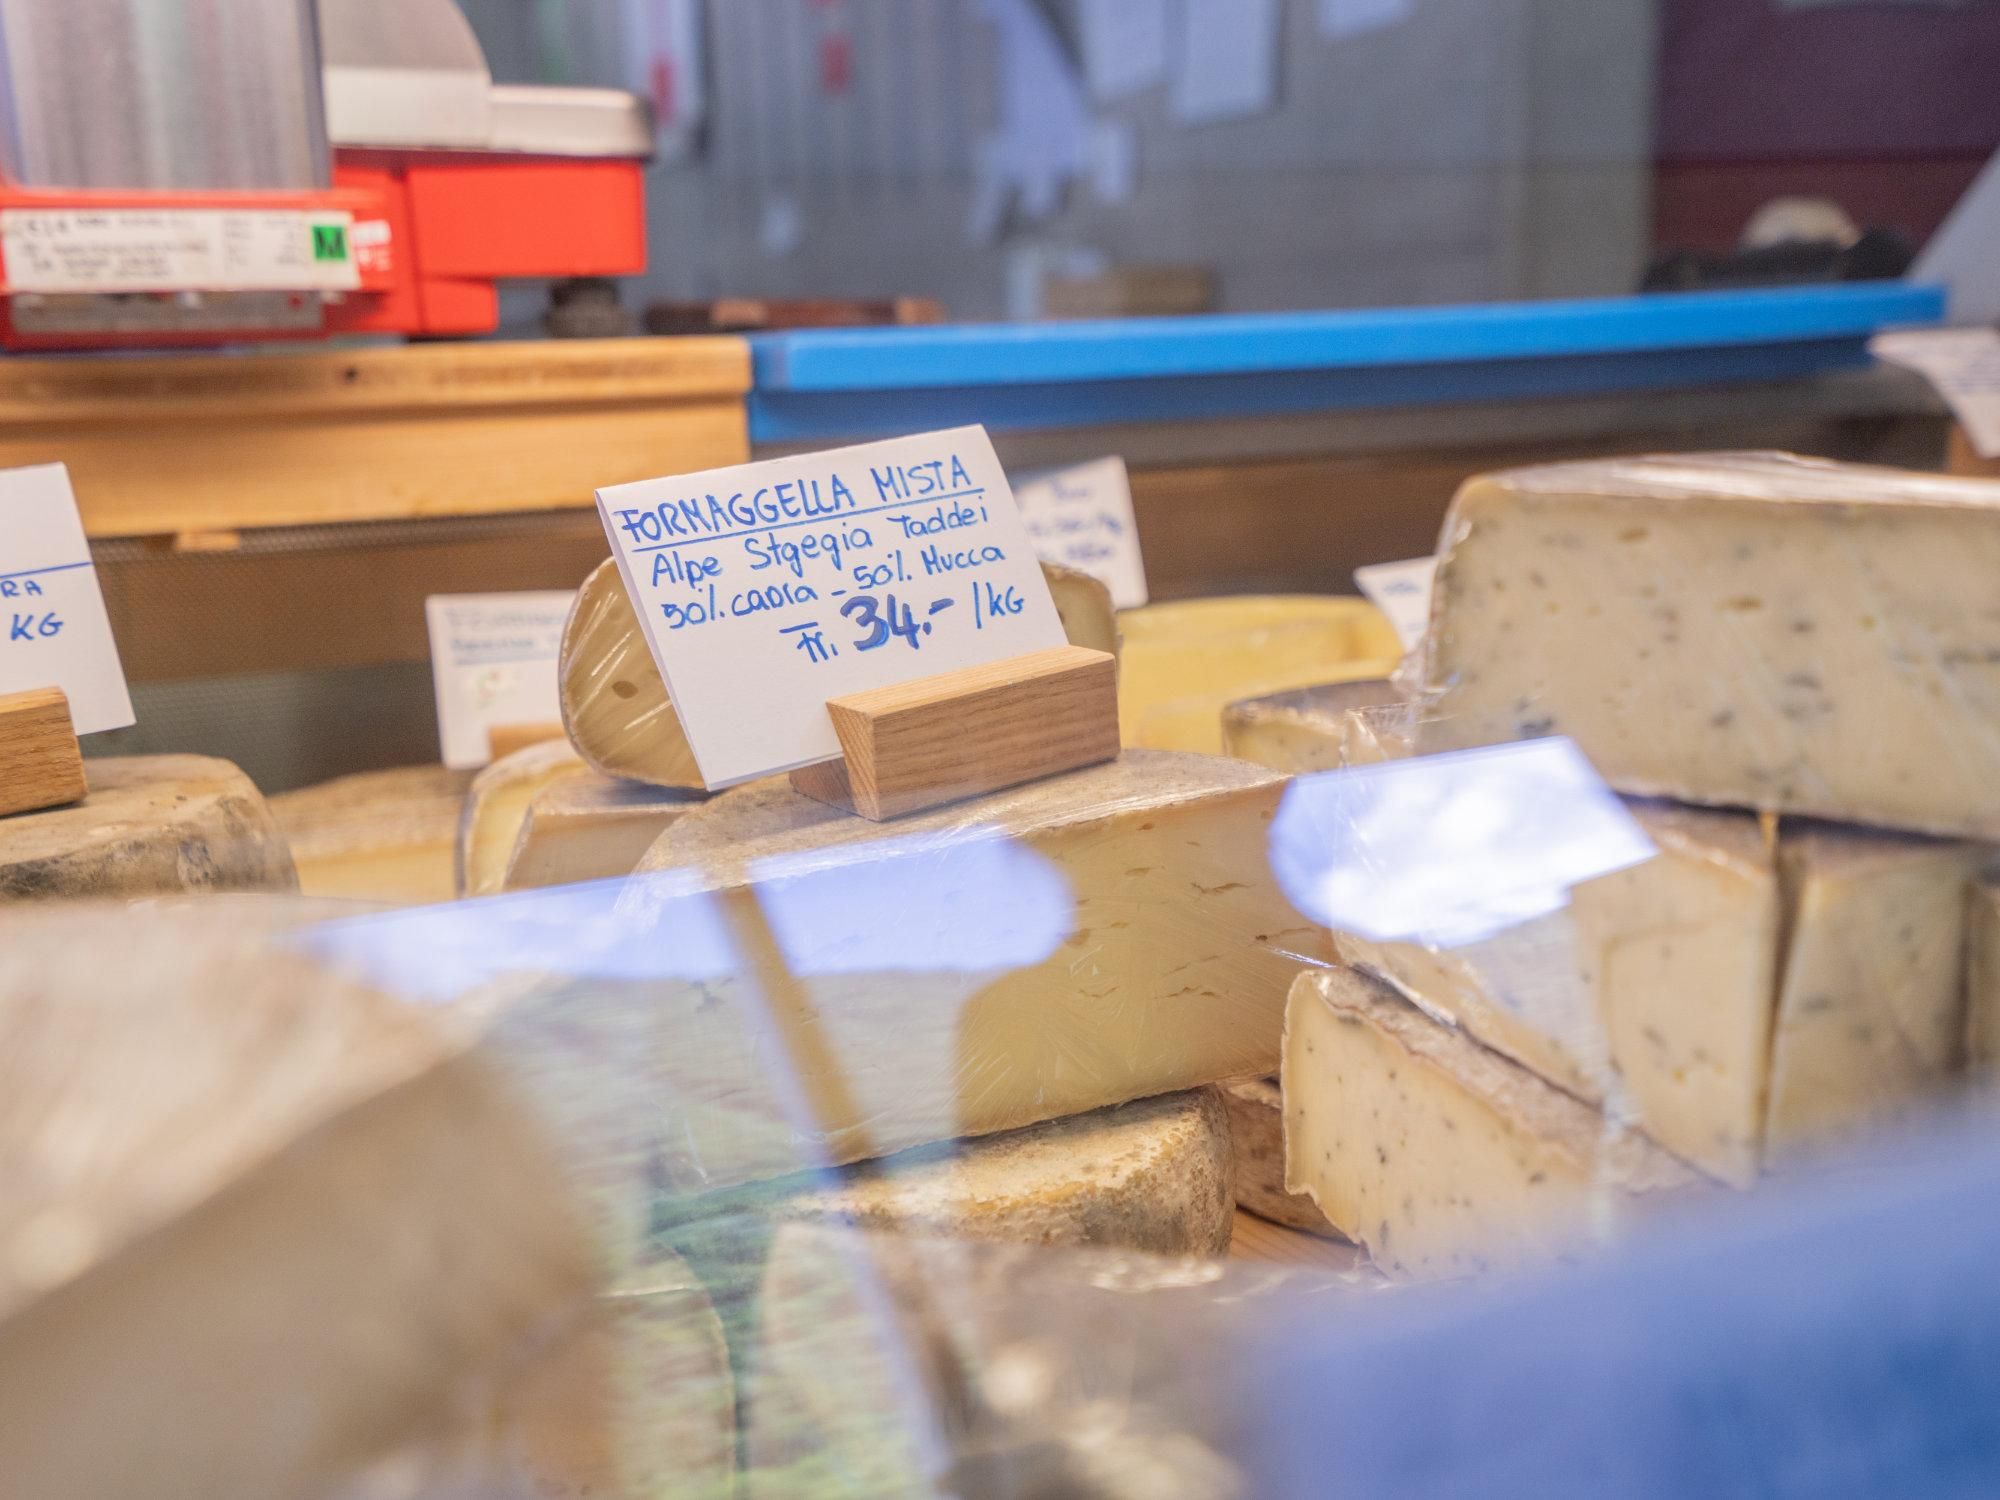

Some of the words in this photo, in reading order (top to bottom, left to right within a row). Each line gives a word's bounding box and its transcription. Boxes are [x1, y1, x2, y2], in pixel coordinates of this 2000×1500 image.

[613, 474, 855, 543] FORMAGGELLA
[870, 454, 972, 502] MISTA
[652, 551, 723, 589] Alpe
[886, 495, 988, 539] Taddei
[853, 549, 913, 590] 50%
[920, 545, 1006, 575] Mucca
[11, 612, 64, 641] KG
